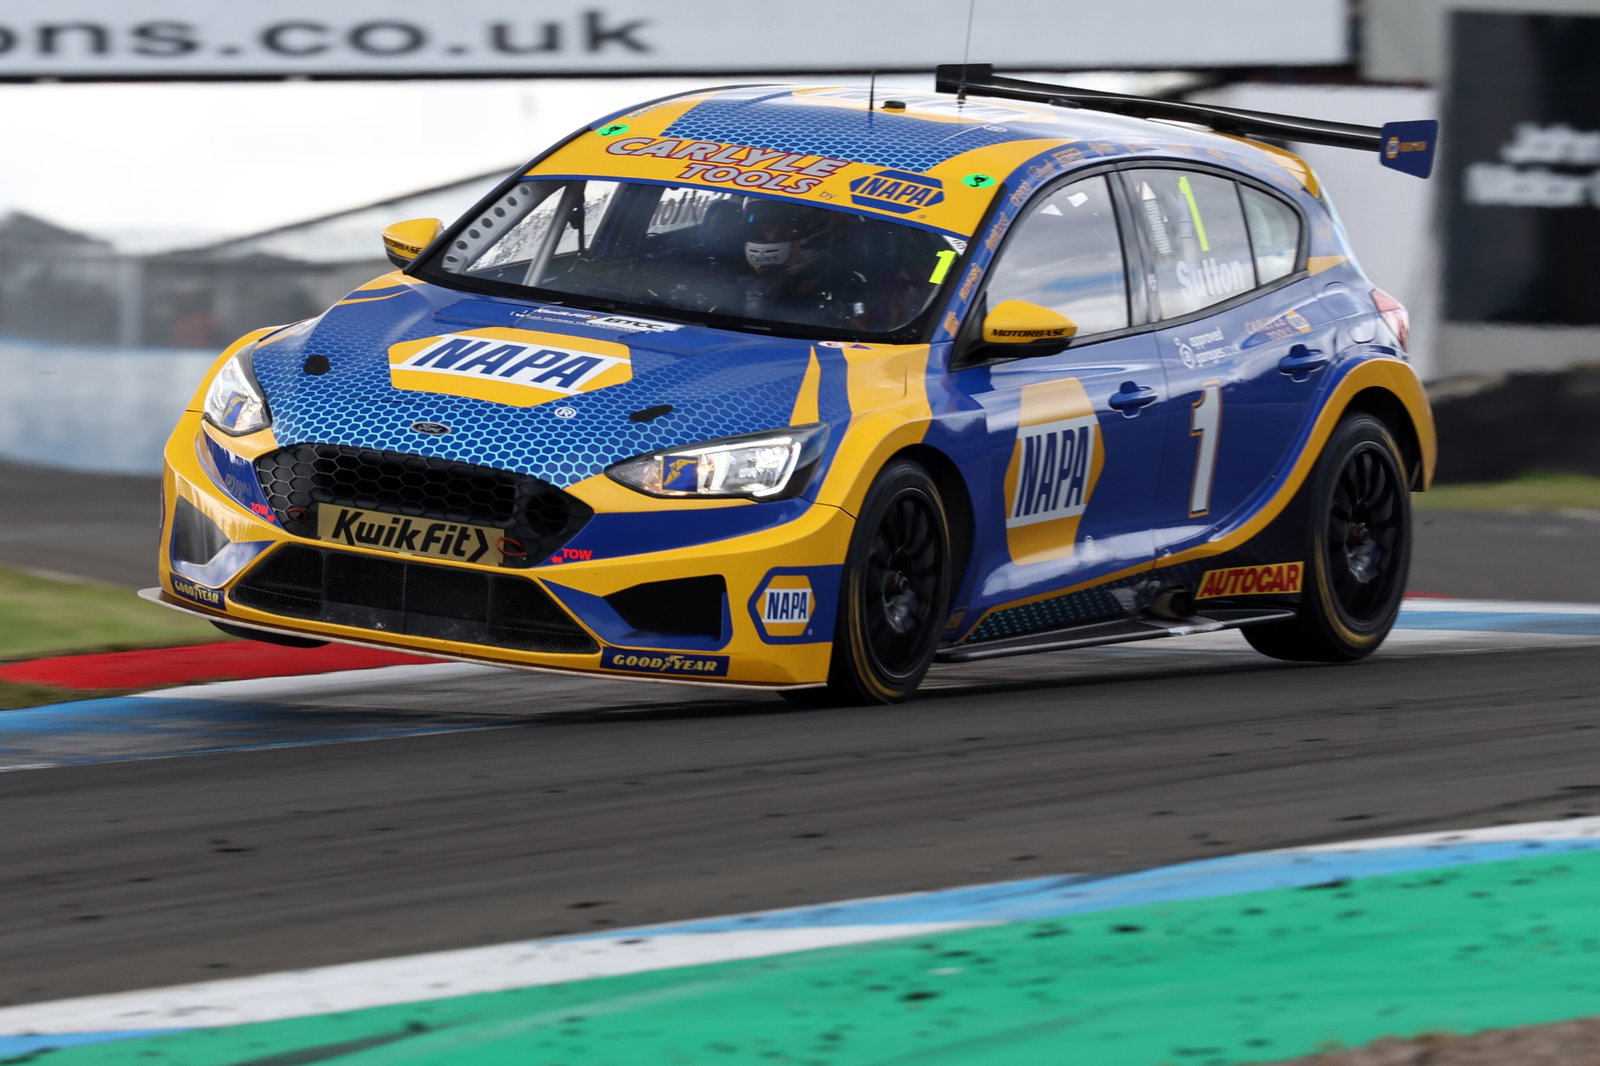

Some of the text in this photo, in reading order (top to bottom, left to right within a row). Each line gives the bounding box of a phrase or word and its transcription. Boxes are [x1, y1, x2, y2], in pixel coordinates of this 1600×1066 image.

[0, 8, 658, 57] ns.co.uk
[606, 137, 850, 177] CARLYLE
[679, 163, 825, 195] TOOLS
[858, 177, 933, 206] NAPA
[1177, 176, 1210, 251] 1
[928, 249, 957, 285] 1
[1175, 257, 1246, 301] Sutton
[411, 337, 605, 389] NAPA
[1189, 380, 1222, 518] 1
[1014, 424, 1090, 518] NAPA
[250, 502, 270, 516] TOW
[562, 548, 593, 560] TOW
[174, 580, 220, 605] GOODYEAR
[1199, 564, 1301, 598] AUTOCAR
[767, 591, 808, 620] NAPA
[612, 653, 718, 672] GOODYEAR
